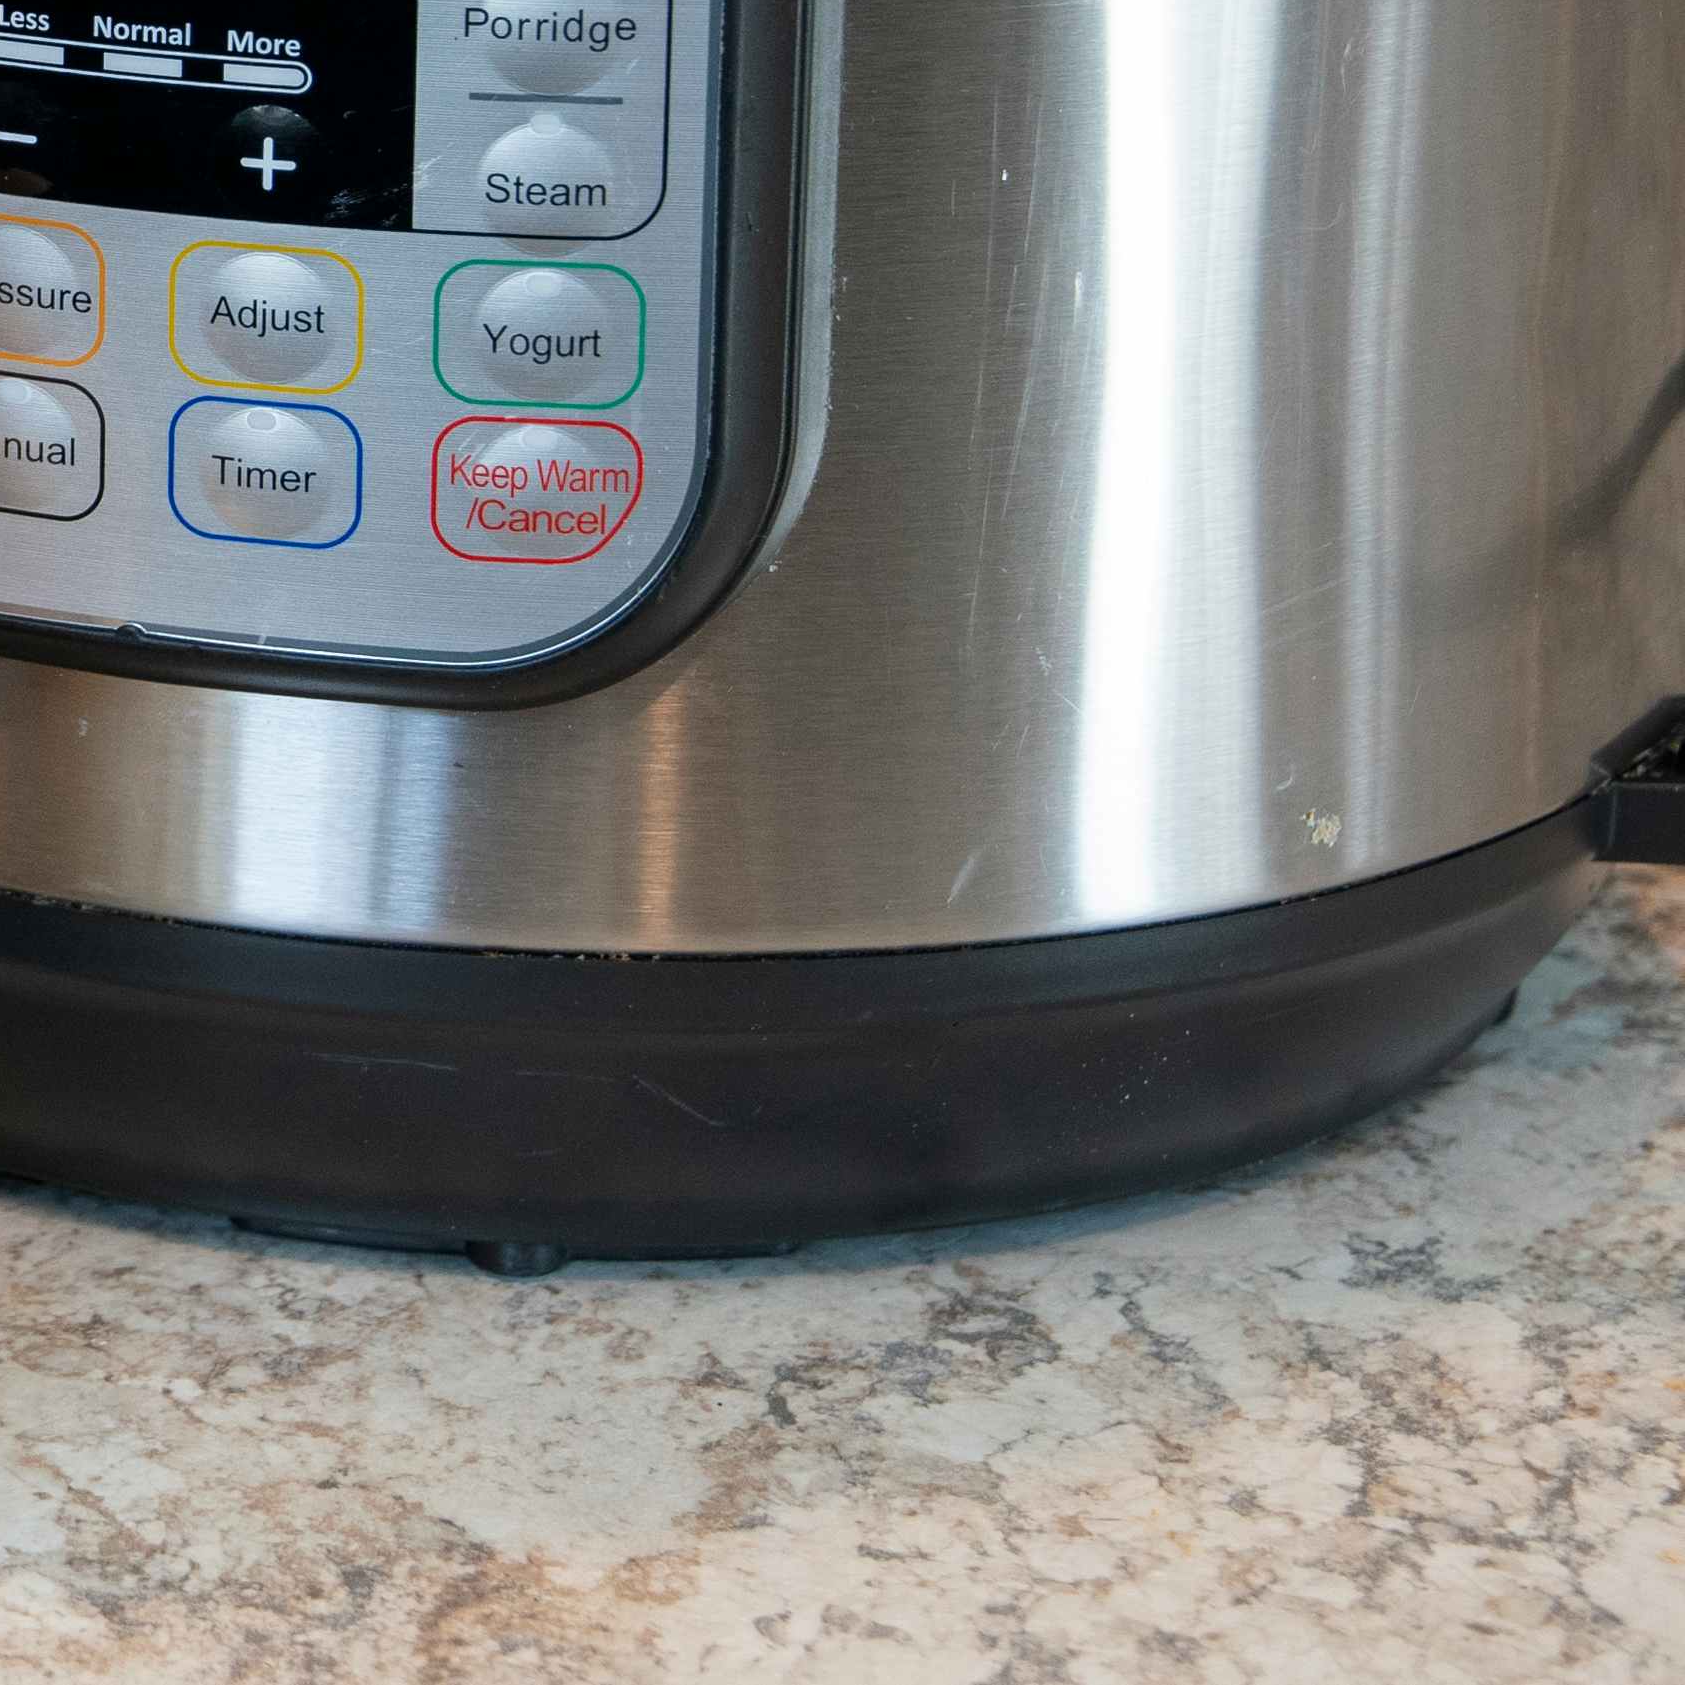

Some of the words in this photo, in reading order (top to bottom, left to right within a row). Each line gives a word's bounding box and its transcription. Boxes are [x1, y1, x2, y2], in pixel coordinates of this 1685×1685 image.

[92, 16, 191, 48] Normal
[226, 32, 301, 57] More
[465, 8, 637, 51] Porridge
[486, 173, 606, 206] Steam
[211, 296, 324, 337] Adjust
[483, 324, 601, 364] Yogurt
[212, 455, 316, 492] Timer
[451, 455, 527, 497] Keep
[538, 460, 629, 492] Warm
[467, 500, 608, 539] /Cancel
